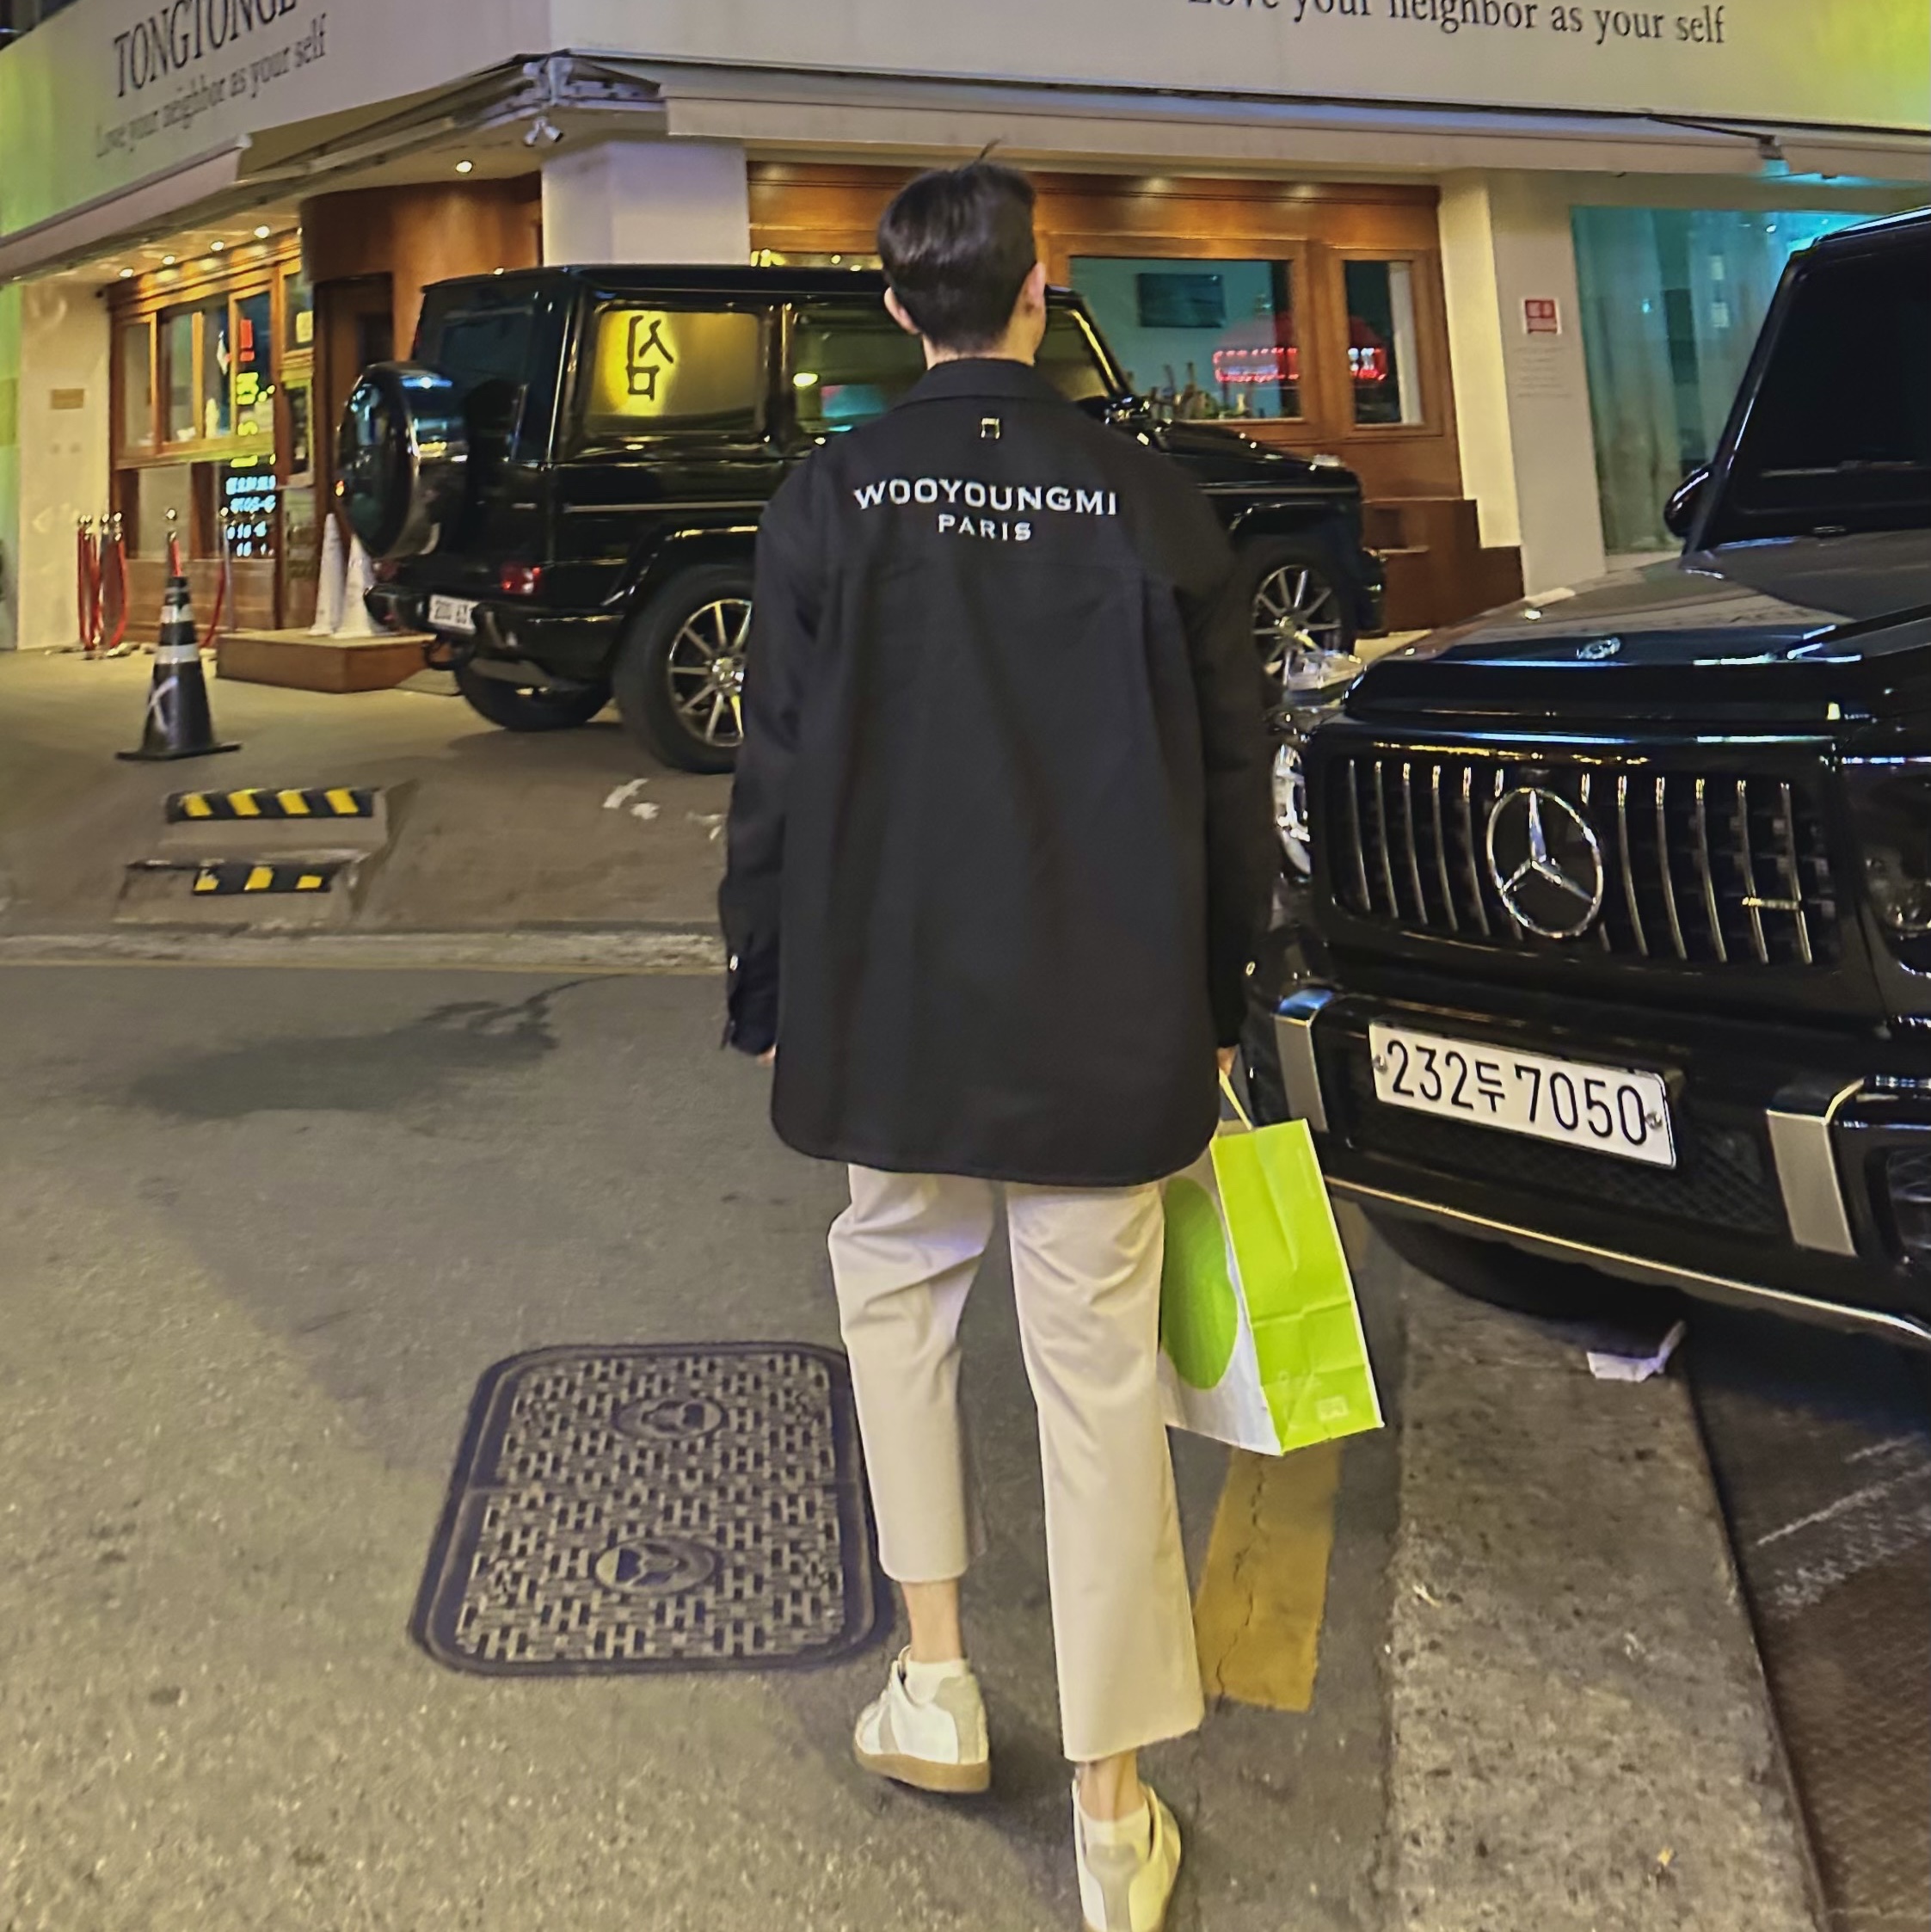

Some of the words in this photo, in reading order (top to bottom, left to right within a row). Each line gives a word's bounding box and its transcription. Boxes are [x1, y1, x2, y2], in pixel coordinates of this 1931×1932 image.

[294, 12, 326, 68] self
[1551, 5, 1584, 32] as
[1591, 9, 1664, 45] your
[1676, 4, 1725, 43] self
[852, 476, 1117, 516] WOOYOUNGMI
[938, 513, 1032, 542] PARIS
